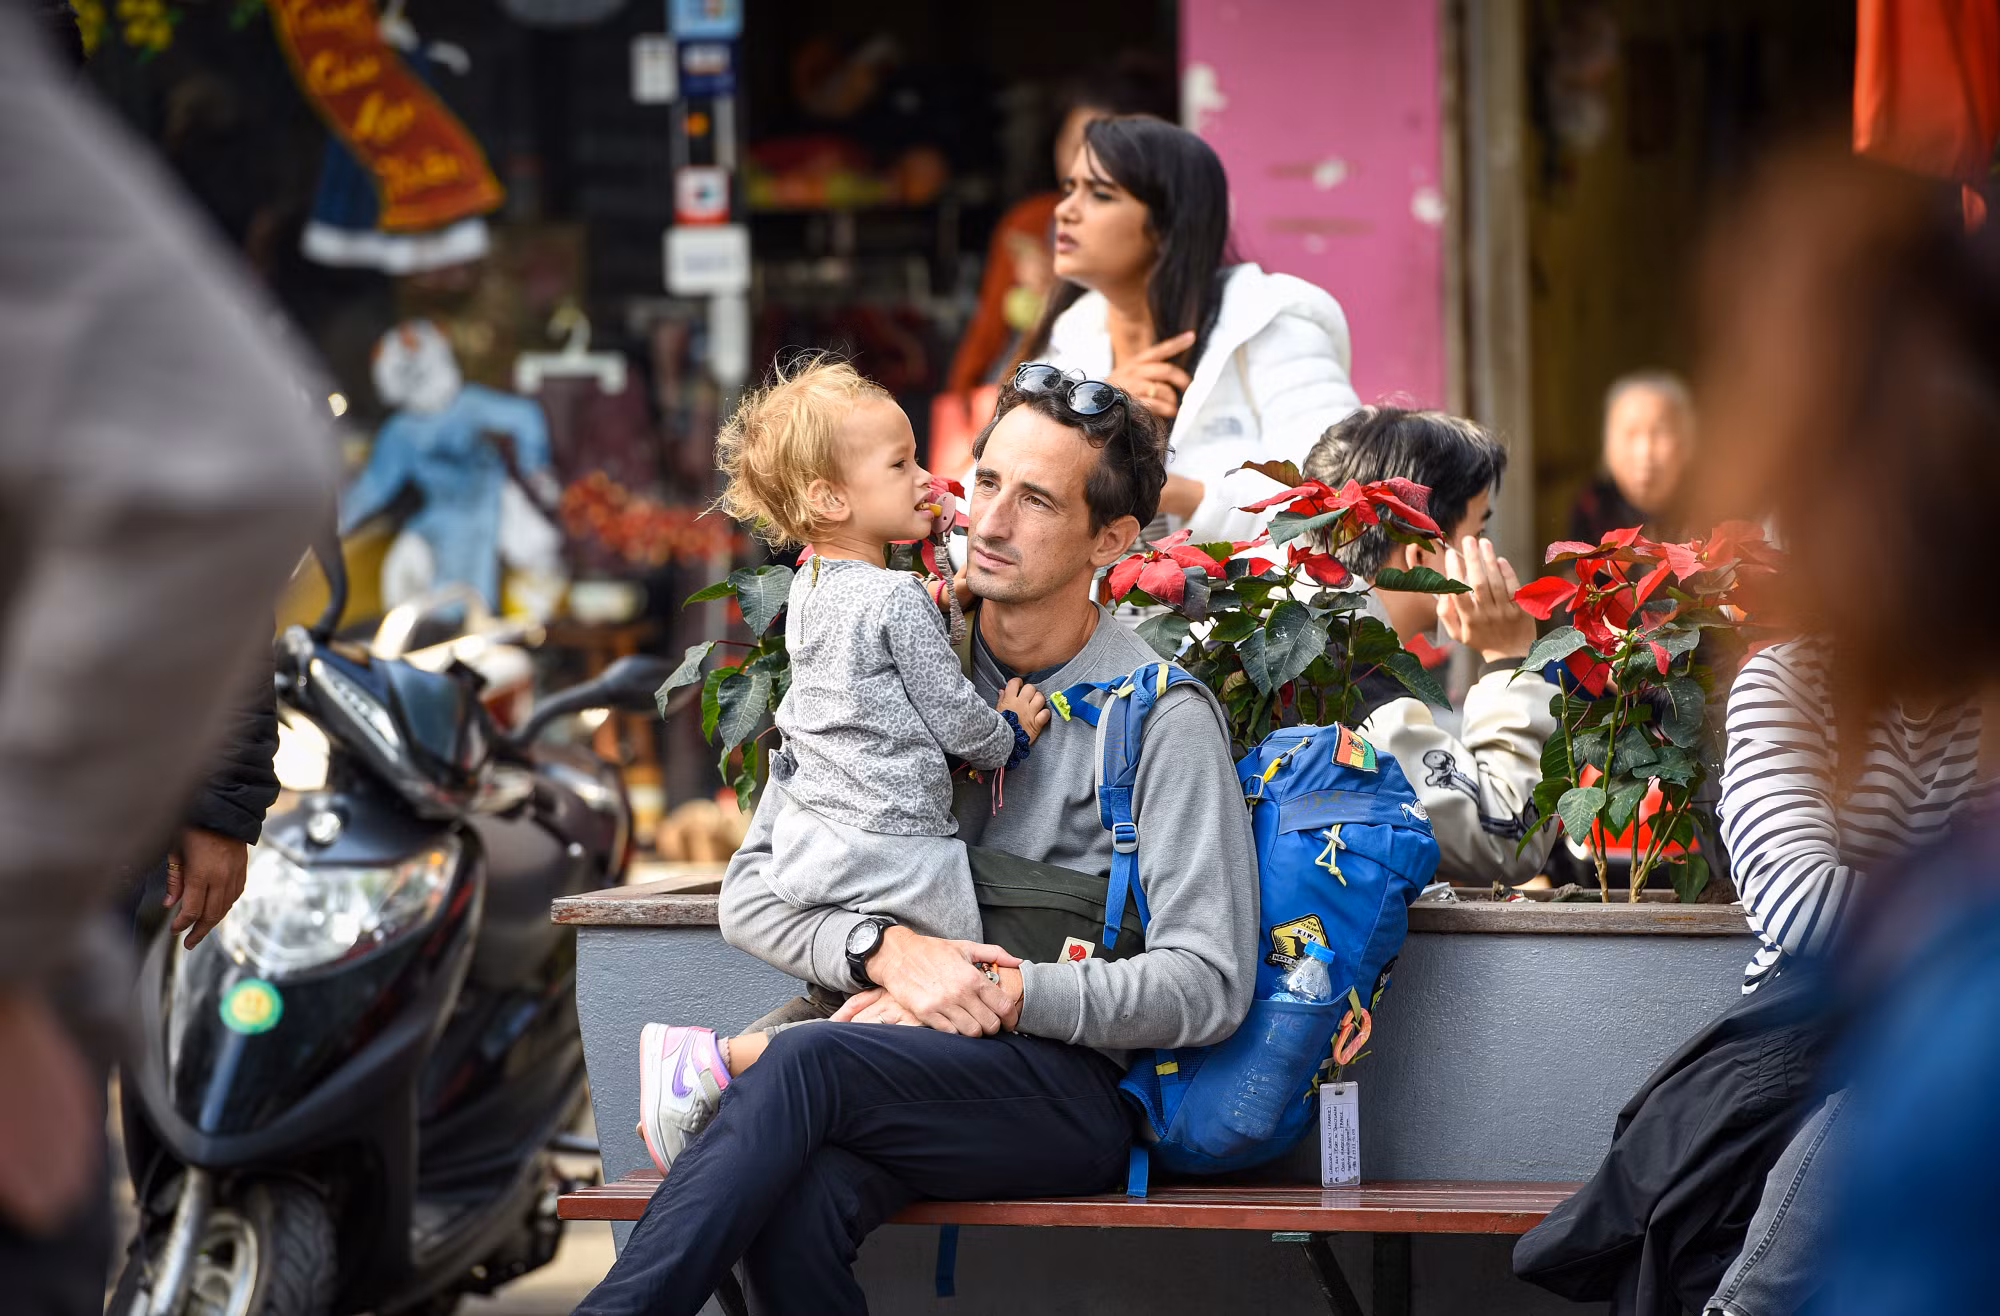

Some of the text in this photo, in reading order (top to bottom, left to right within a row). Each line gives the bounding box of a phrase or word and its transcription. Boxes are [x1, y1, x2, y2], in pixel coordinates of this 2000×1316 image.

[1300, 922, 1320, 934] ZEALAND
[1296, 928, 1317, 942] KIWI
[1273, 954, 1290, 963] NEXT
